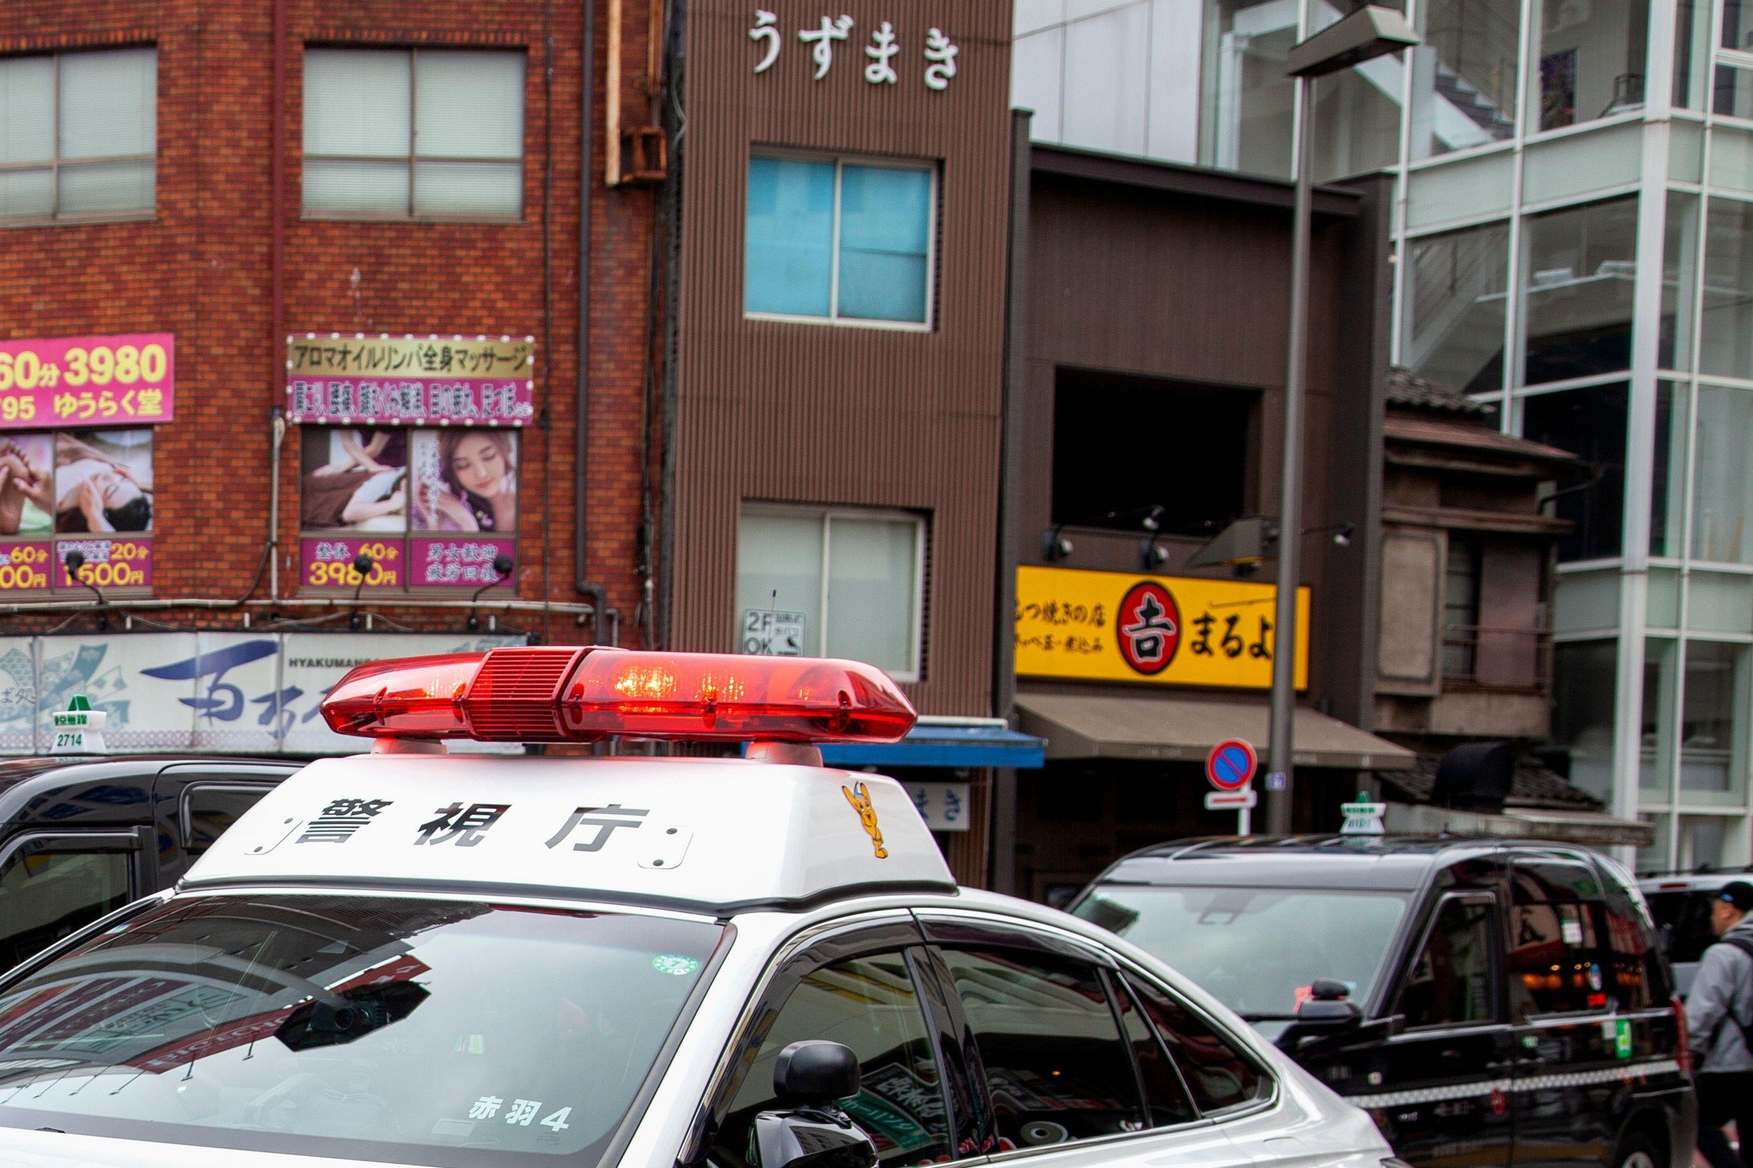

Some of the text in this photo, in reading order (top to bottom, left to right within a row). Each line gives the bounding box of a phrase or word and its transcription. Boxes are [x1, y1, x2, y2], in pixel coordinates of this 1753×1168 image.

[749, 10, 959, 91] うずまき
[63, 343, 168, 386] 3980
[53, 387, 164, 418] ゆうらく堂
[1123, 592, 1177, 663] 吉
[57, 733, 83, 747] 2714
[296, 797, 650, 853] 警視庁
